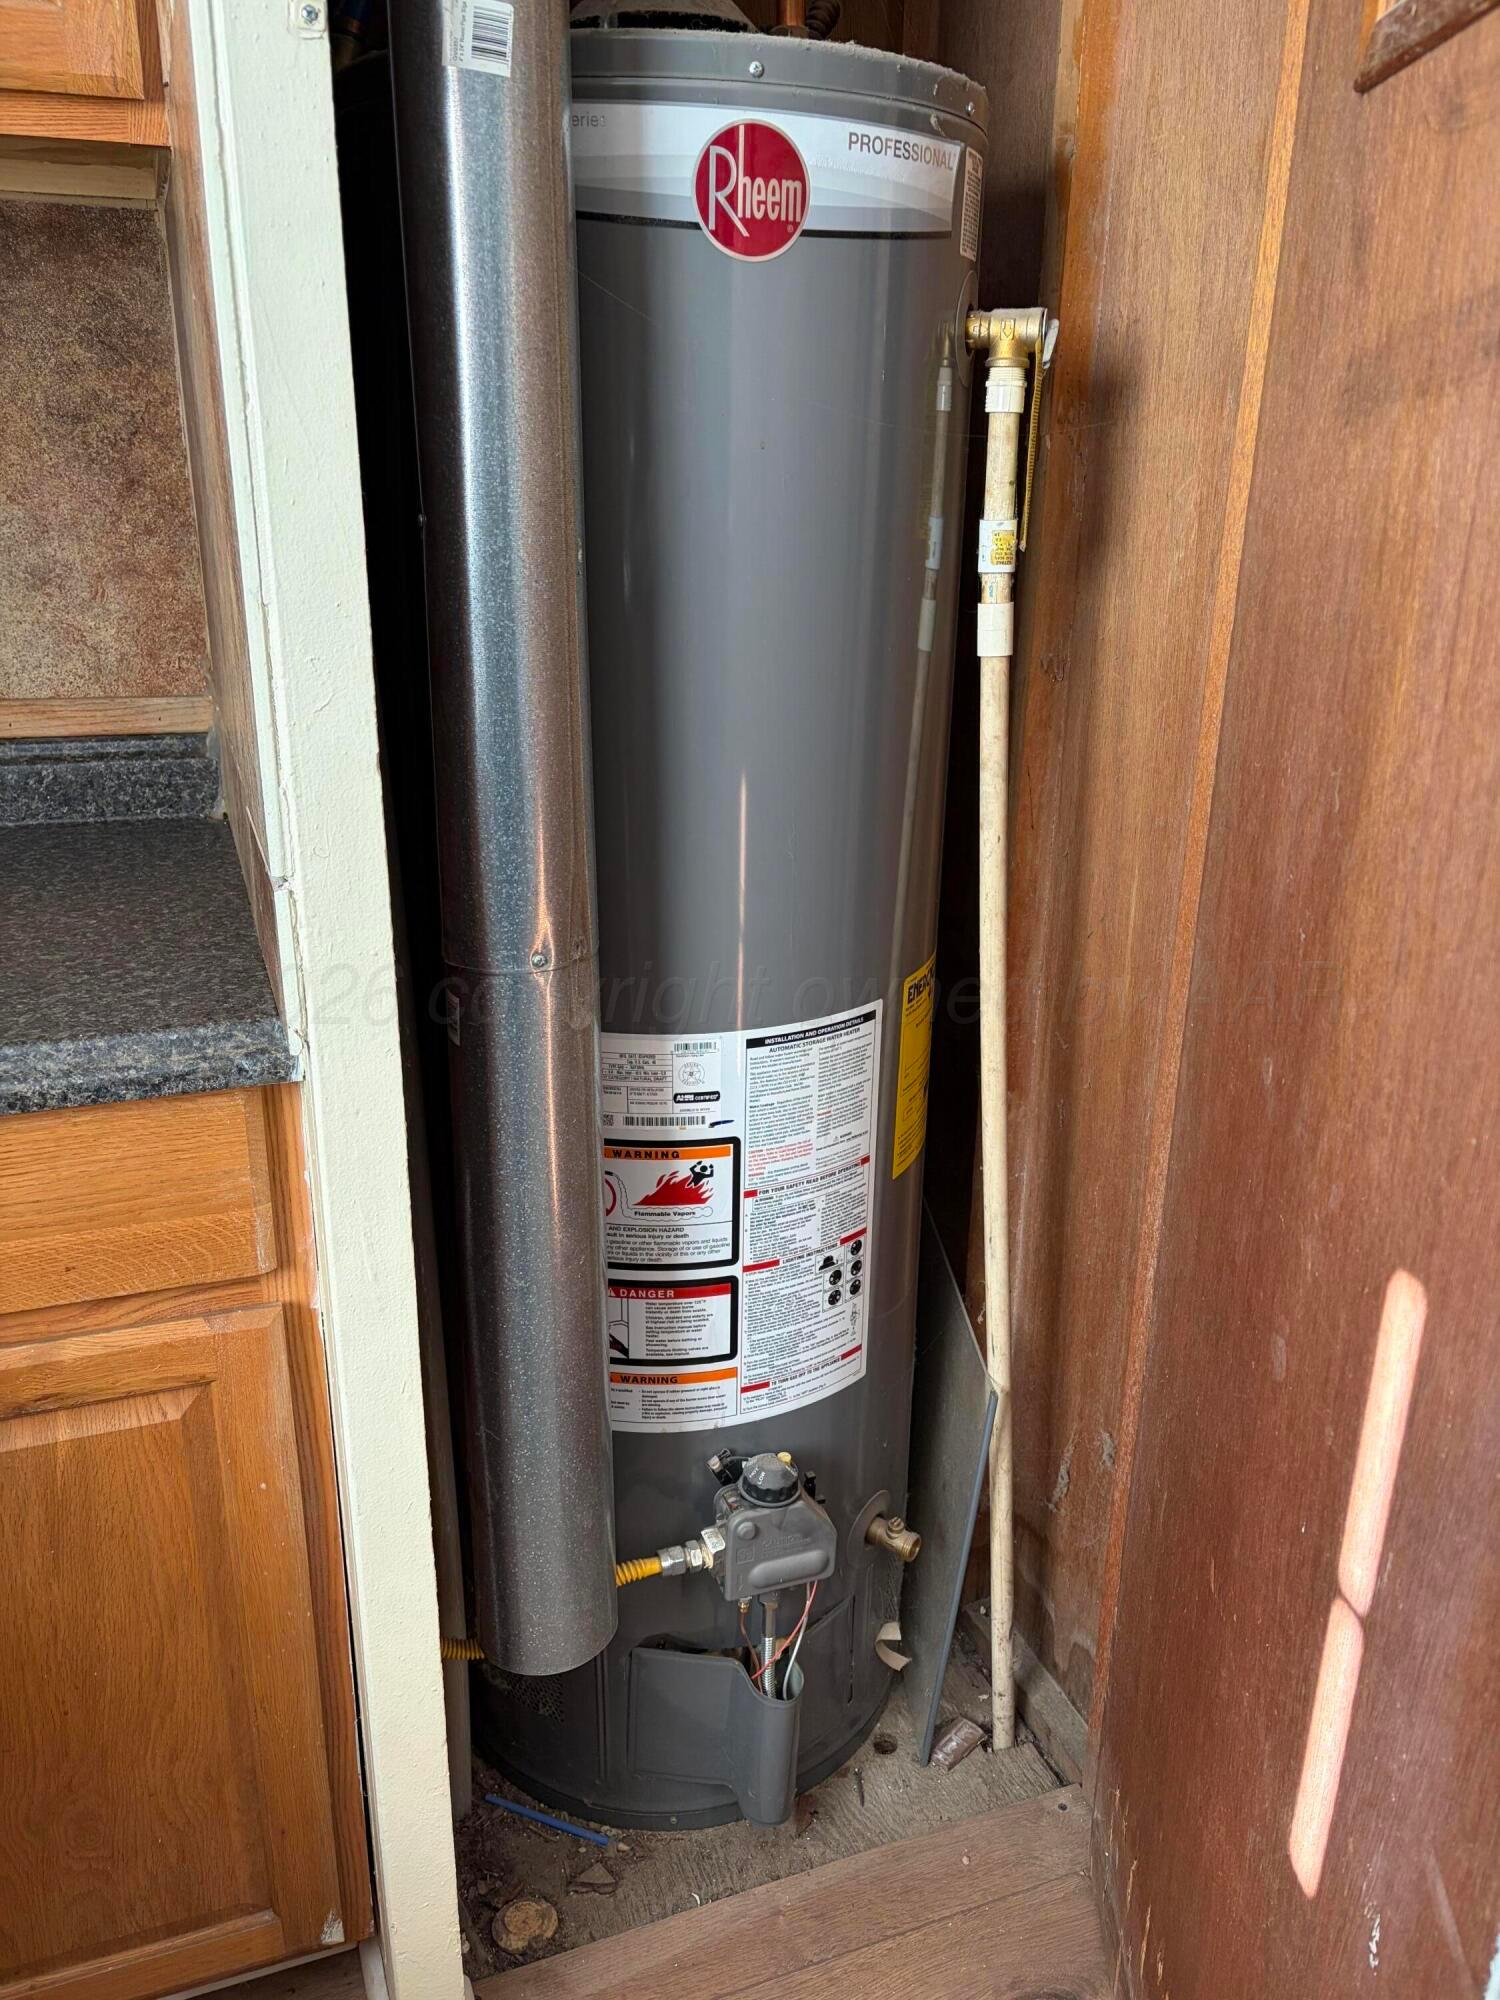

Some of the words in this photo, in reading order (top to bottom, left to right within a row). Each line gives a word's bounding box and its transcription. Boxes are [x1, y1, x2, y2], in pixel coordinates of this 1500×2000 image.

[848, 131, 954, 171] PROFESSIONAL
[708, 124, 802, 237] Rheem
[764, 1032, 804, 1044] INSTALLATION
[818, 1022, 845, 1034] OPERATION
[846, 1016, 864, 1028] DETAILS
[769, 1042, 801, 1053] AUTOMATIC
[802, 1038, 826, 1048] STORAGE
[826, 1032, 843, 1042] WATER
[844, 1027, 861, 1037] HEATER
[612, 1149, 680, 1160] WARNING
[786, 1181, 805, 1191] SAFETY
[820, 1172, 836, 1181] BEFORE
[838, 1162, 860, 1174] OPERATING
[782, 1254, 805, 1264] LIGHTING
[806, 1244, 838, 1257] INSTRUCTIONS
[620, 1289, 675, 1298] DANGER
[620, 1376, 678, 1384] WARNING
